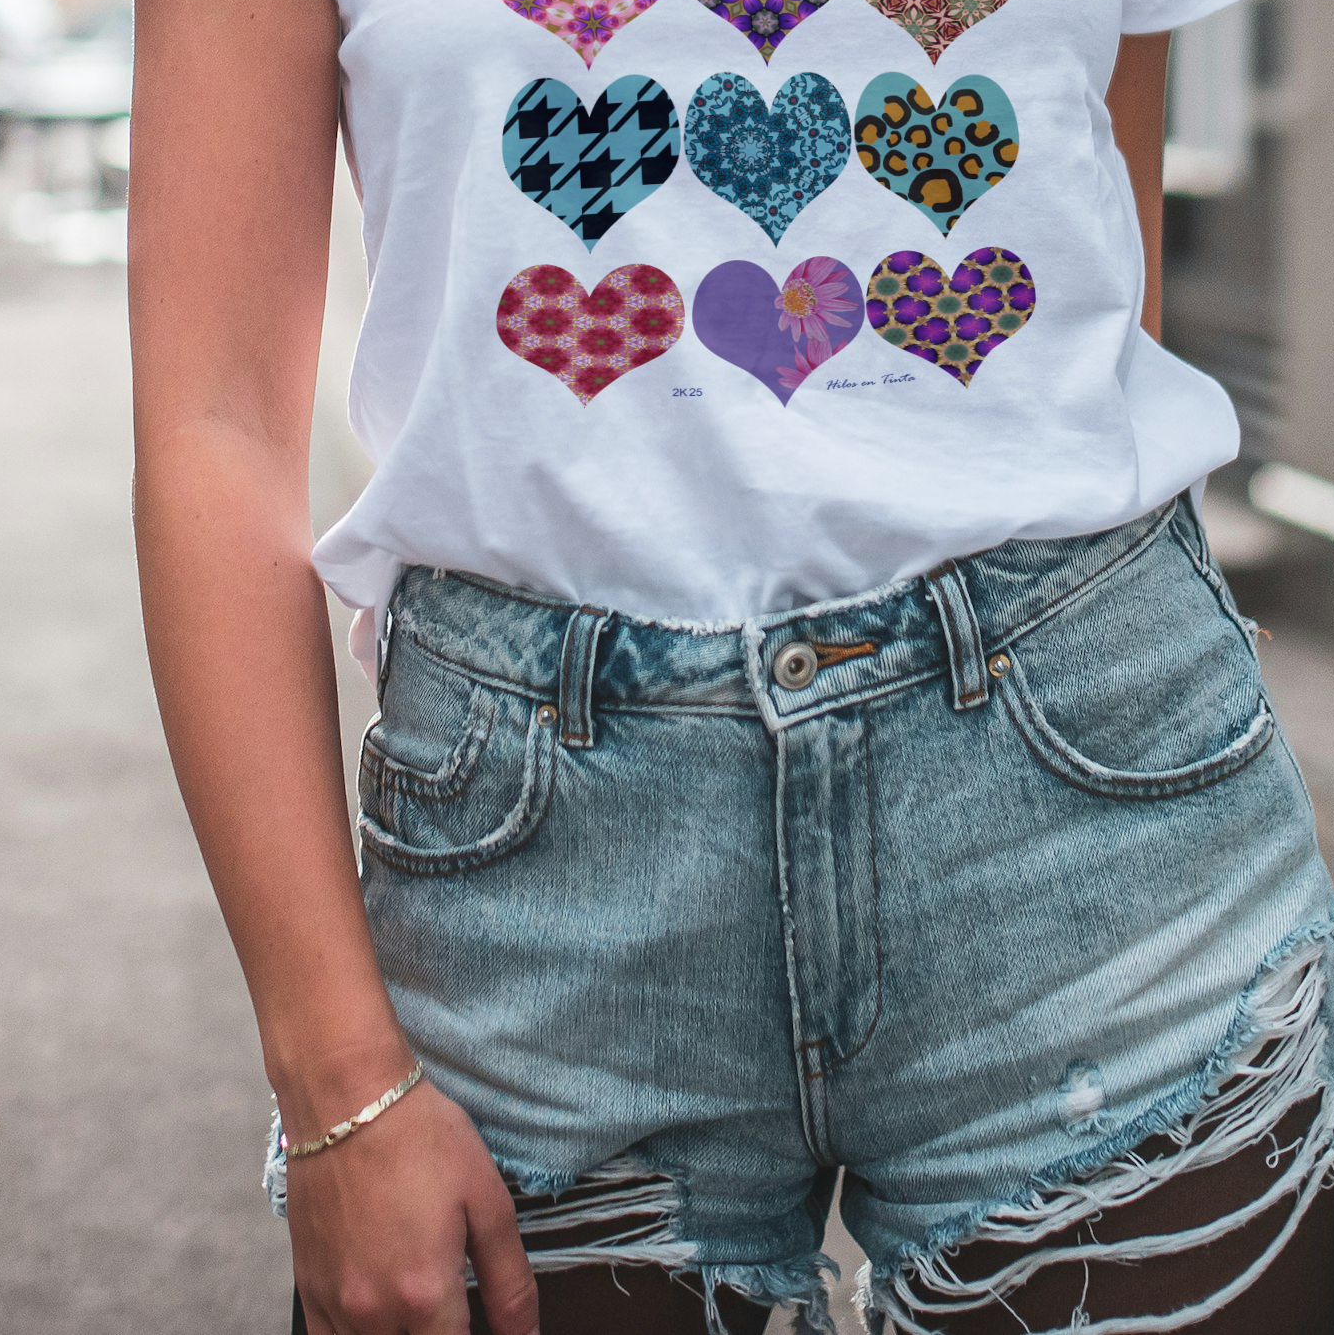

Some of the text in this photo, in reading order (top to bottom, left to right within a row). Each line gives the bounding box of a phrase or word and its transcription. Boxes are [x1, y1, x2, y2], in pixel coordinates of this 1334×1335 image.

[826, 378, 858, 390] Hilos
[880, 373, 916, 385] Tinta
[672, 387, 703, 397] 2K25
